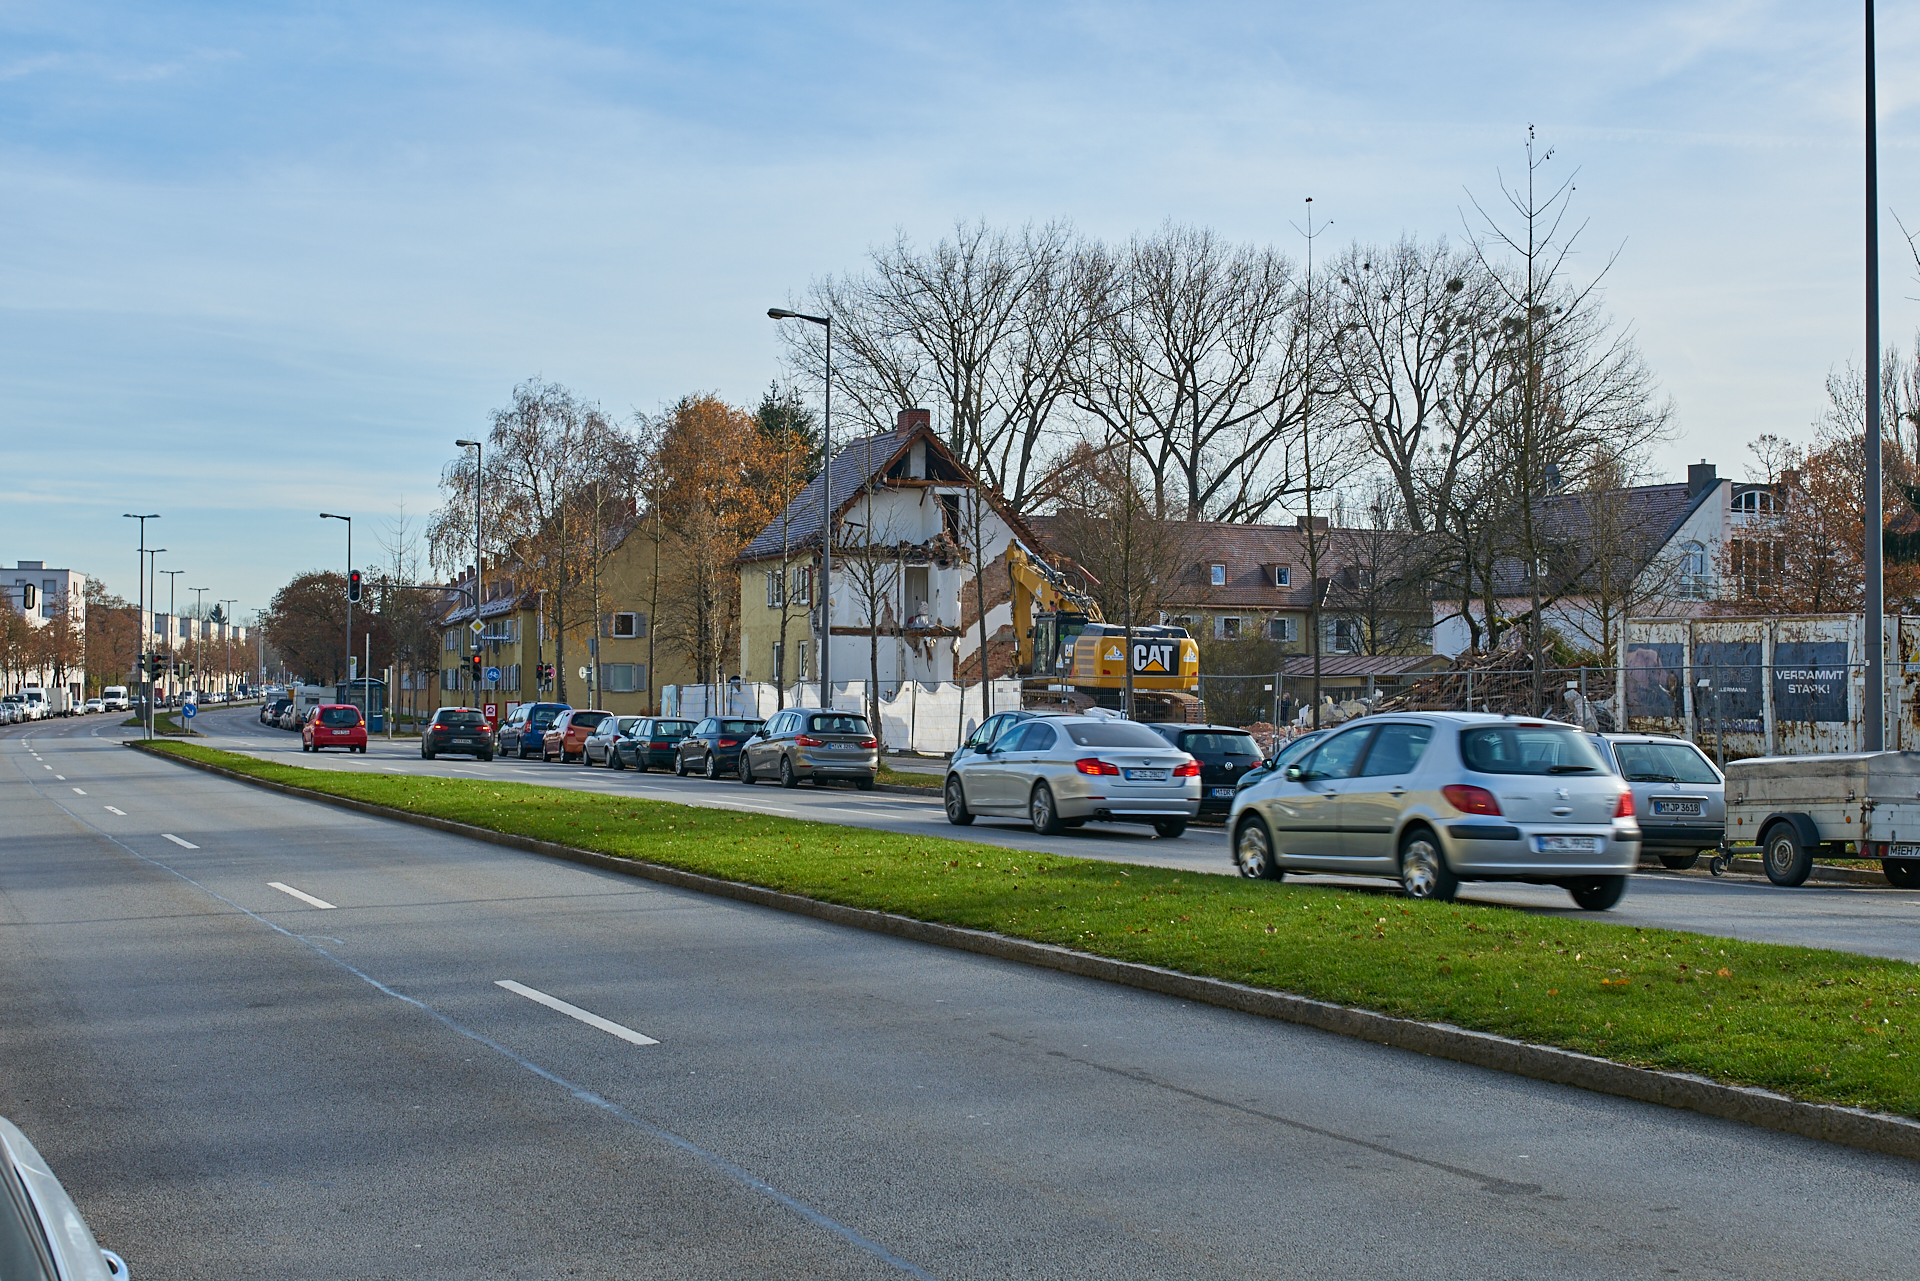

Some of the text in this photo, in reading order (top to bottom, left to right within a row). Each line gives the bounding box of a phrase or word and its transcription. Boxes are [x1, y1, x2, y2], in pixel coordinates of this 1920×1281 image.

[1065, 644, 1074, 657] CAT
[1133, 644, 1173, 671] CAT
[1776, 670, 1844, 680] VERDAMMT
[1788, 684, 1830, 694] STARK!
[1670, 803, 1680, 812] JP
[1681, 804, 1698, 812] 3618
